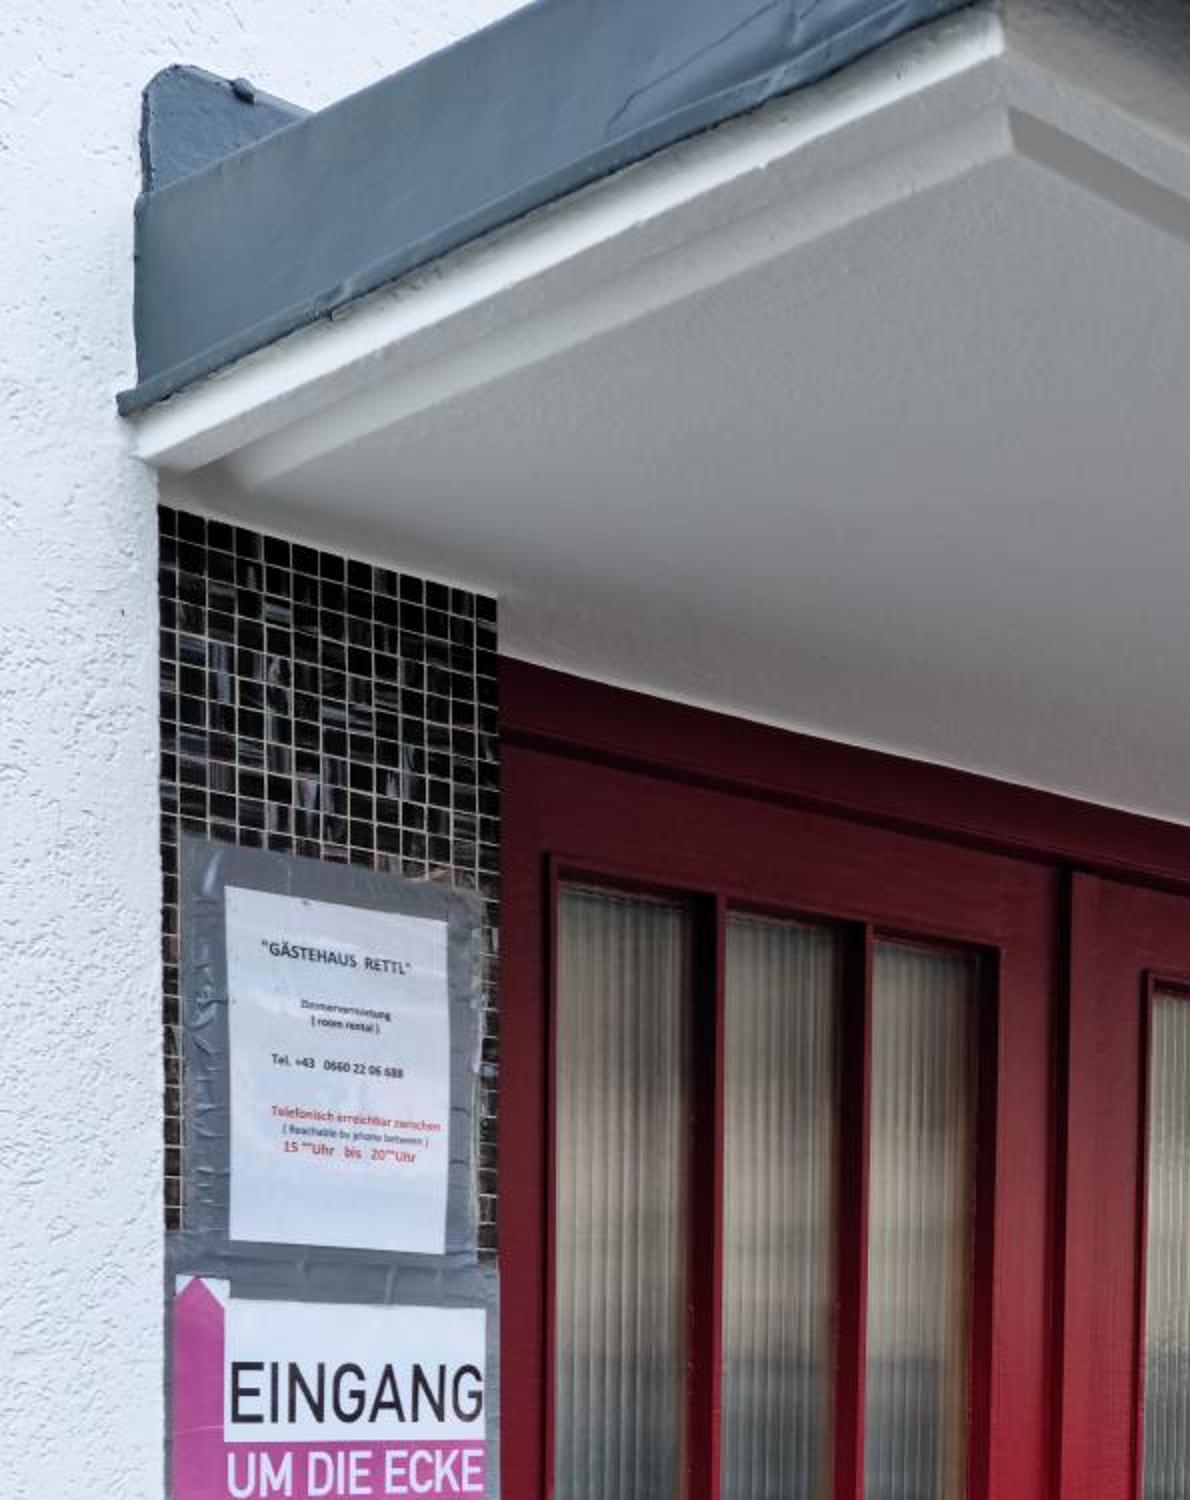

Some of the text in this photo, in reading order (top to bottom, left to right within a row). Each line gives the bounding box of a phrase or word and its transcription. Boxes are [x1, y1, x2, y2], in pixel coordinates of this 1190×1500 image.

[230, 1361, 484, 1424] EINGANG
[226, 1448, 485, 1499] UM DIE ECKE
